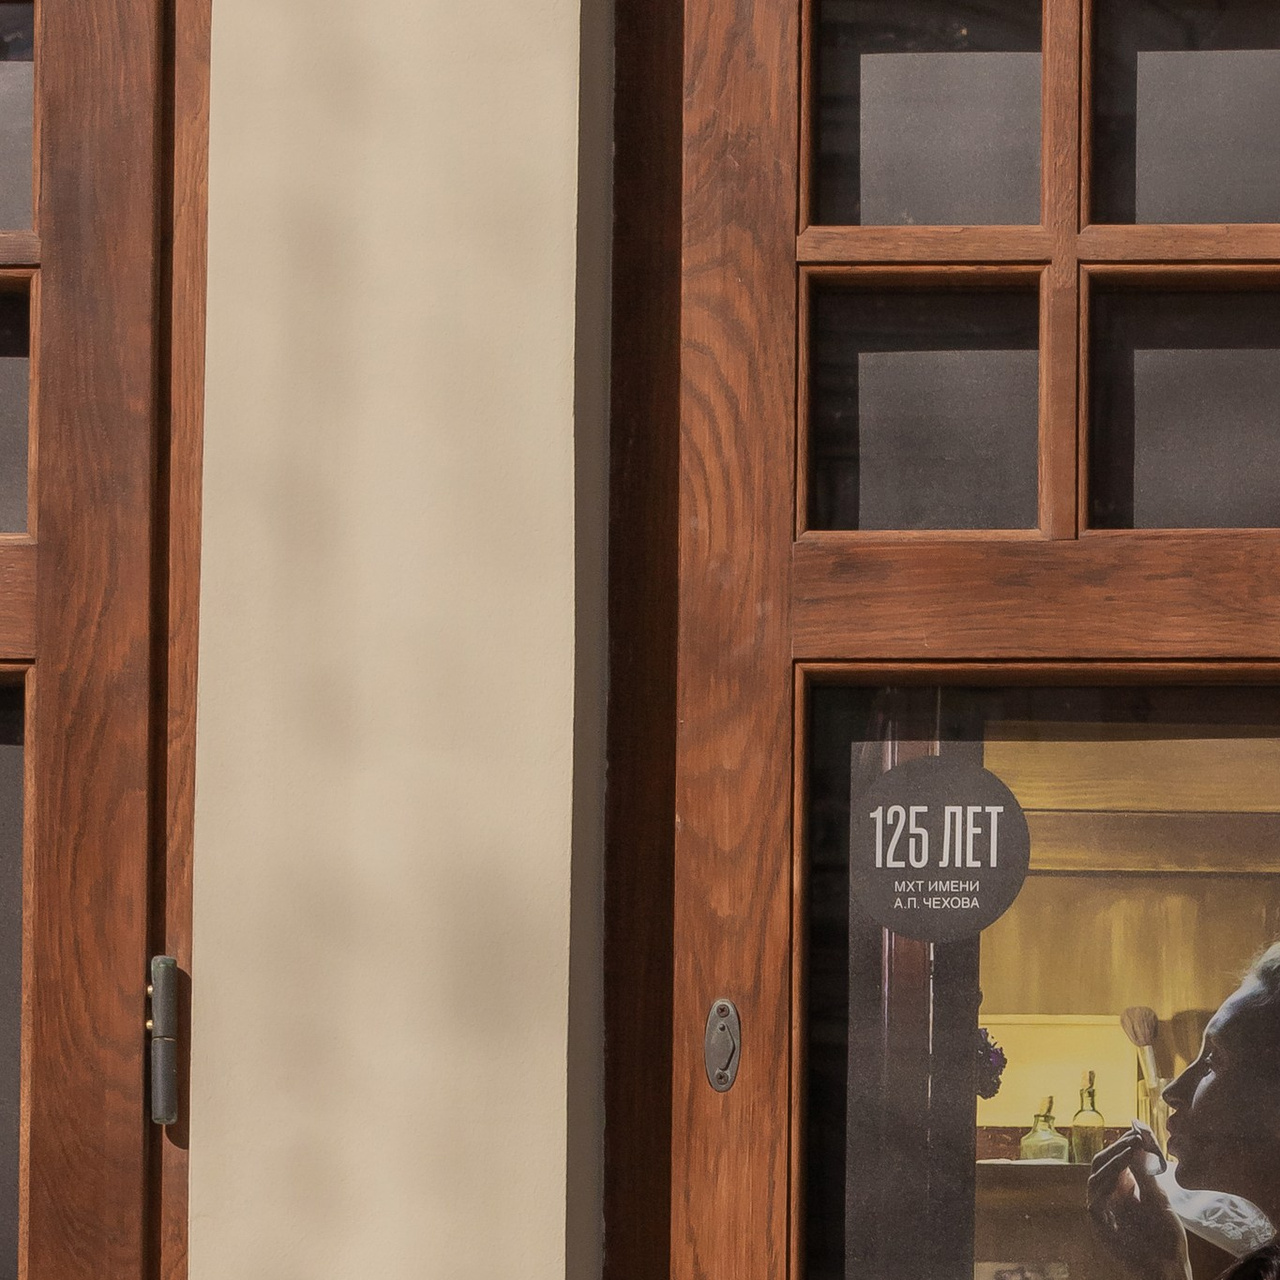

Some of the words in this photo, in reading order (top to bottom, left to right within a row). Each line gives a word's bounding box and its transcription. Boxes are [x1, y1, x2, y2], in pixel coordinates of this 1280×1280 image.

[869, 805, 929, 868] 125
[938, 805, 1004, 868] ЛЕТ
[894, 880, 924, 892] МХТ
[928, 880, 980, 892] ИМЕНИ
[893, 897, 920, 909] А.П.
[923, 897, 980, 909] ЧЕХОВА
